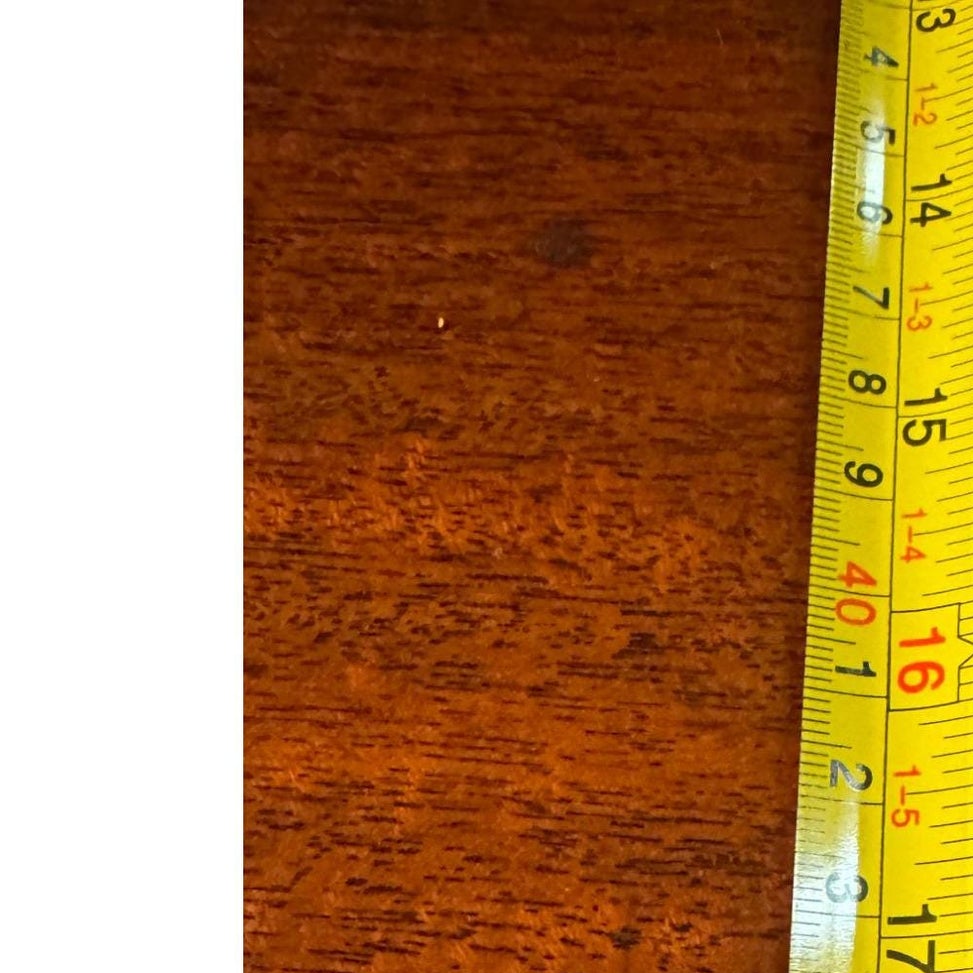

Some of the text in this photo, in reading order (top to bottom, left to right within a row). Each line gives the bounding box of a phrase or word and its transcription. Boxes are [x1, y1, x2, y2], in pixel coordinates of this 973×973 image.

[916, 0, 956, 33] 3
[864, 46, 899, 68] 4
[860, 120, 896, 145] 5
[857, 201, 892, 224] 6
[910, 174, 952, 227] 14
[853, 286, 890, 310] 7
[848, 370, 887, 395] 8
[903, 388, 948, 446] 15
[844, 461, 883, 488] 9
[835, 562, 877, 626] 40
[835, 661, 877, 678] 1
[897, 627, 945, 694] 16
[829, 759, 872, 790] 2
[825, 871, 869, 902] 3
